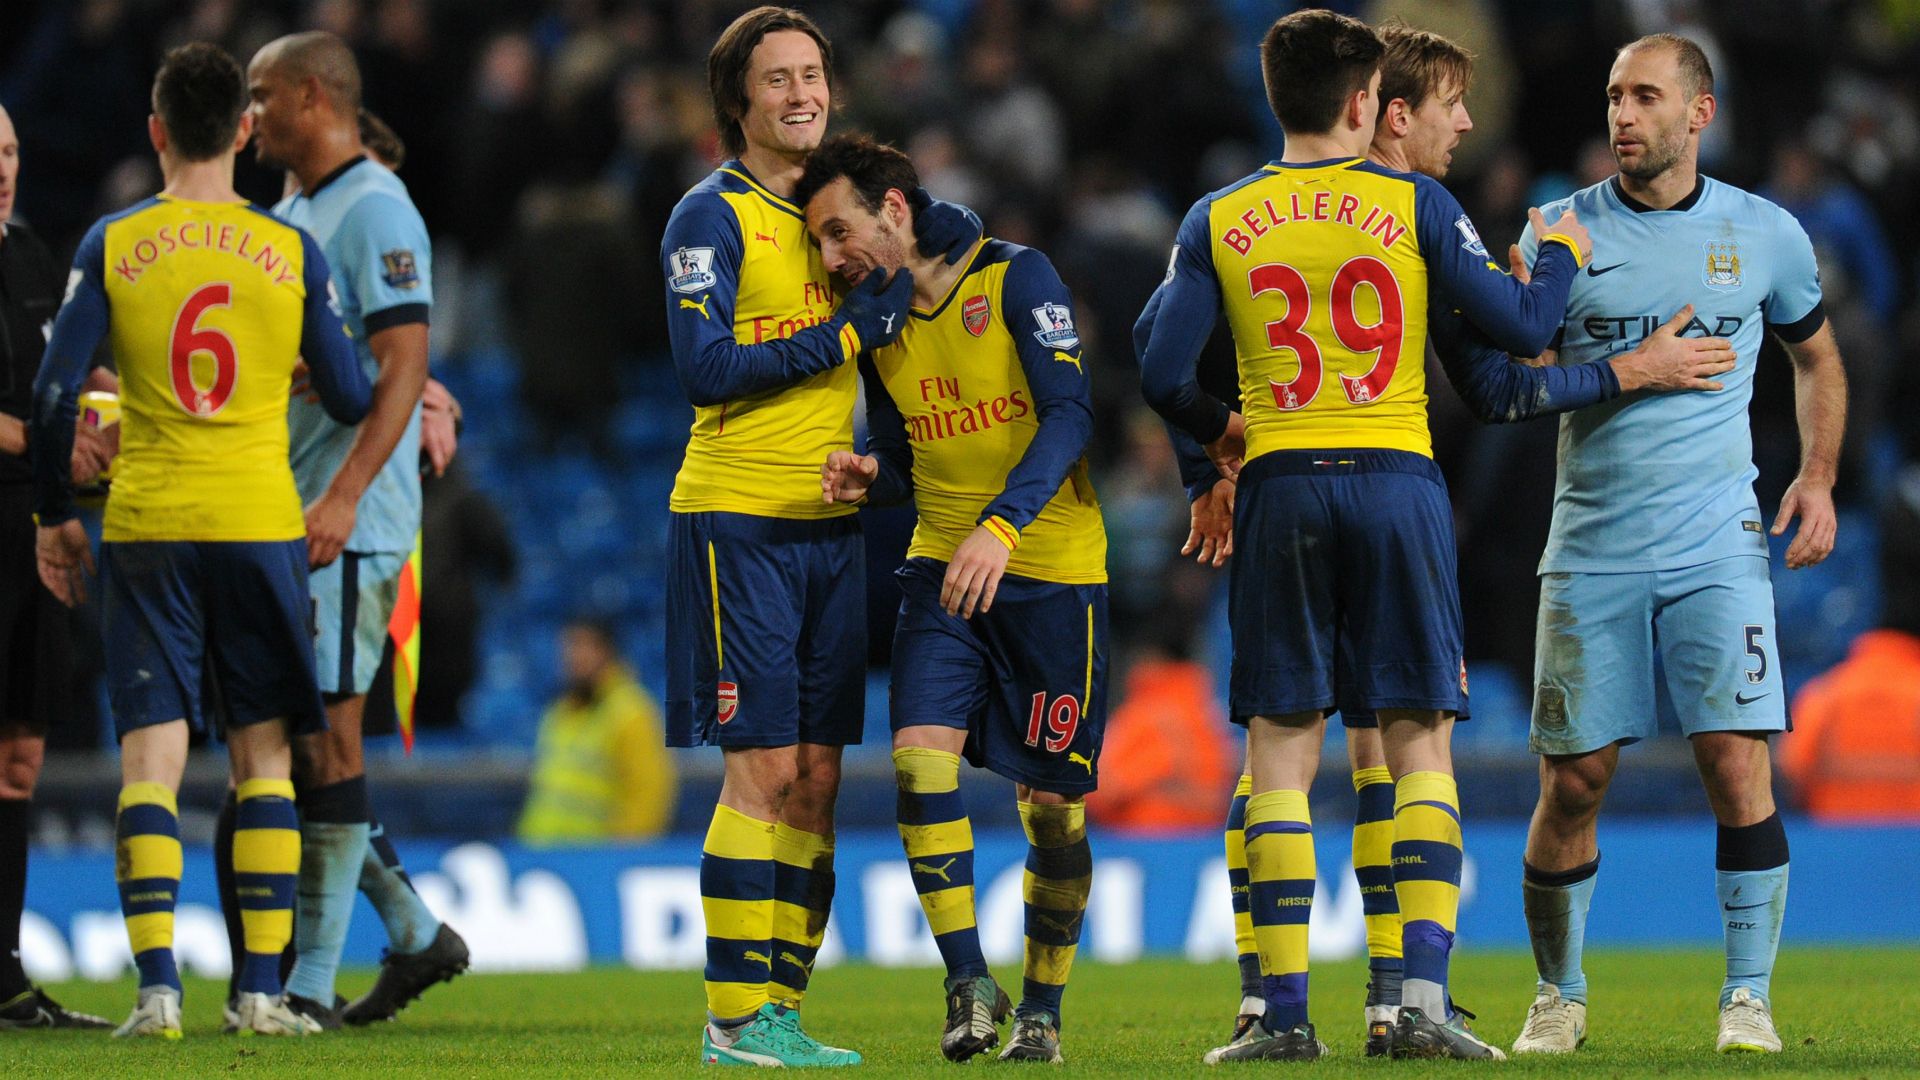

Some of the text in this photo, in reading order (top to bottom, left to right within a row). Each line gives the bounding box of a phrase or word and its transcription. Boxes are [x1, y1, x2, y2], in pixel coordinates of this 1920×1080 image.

[114, 223, 296, 284] KOSCIELNY
[1222, 192, 1406, 257] BELLERIN
[804, 281, 833, 308] Fly
[169, 282, 238, 417] 6
[1247, 255, 1404, 411] 39
[906, 390, 1028, 442] mirates
[919, 376, 960, 402] Fly
[1743, 624, 1768, 684] 5
[1024, 690, 1079, 752] 19
